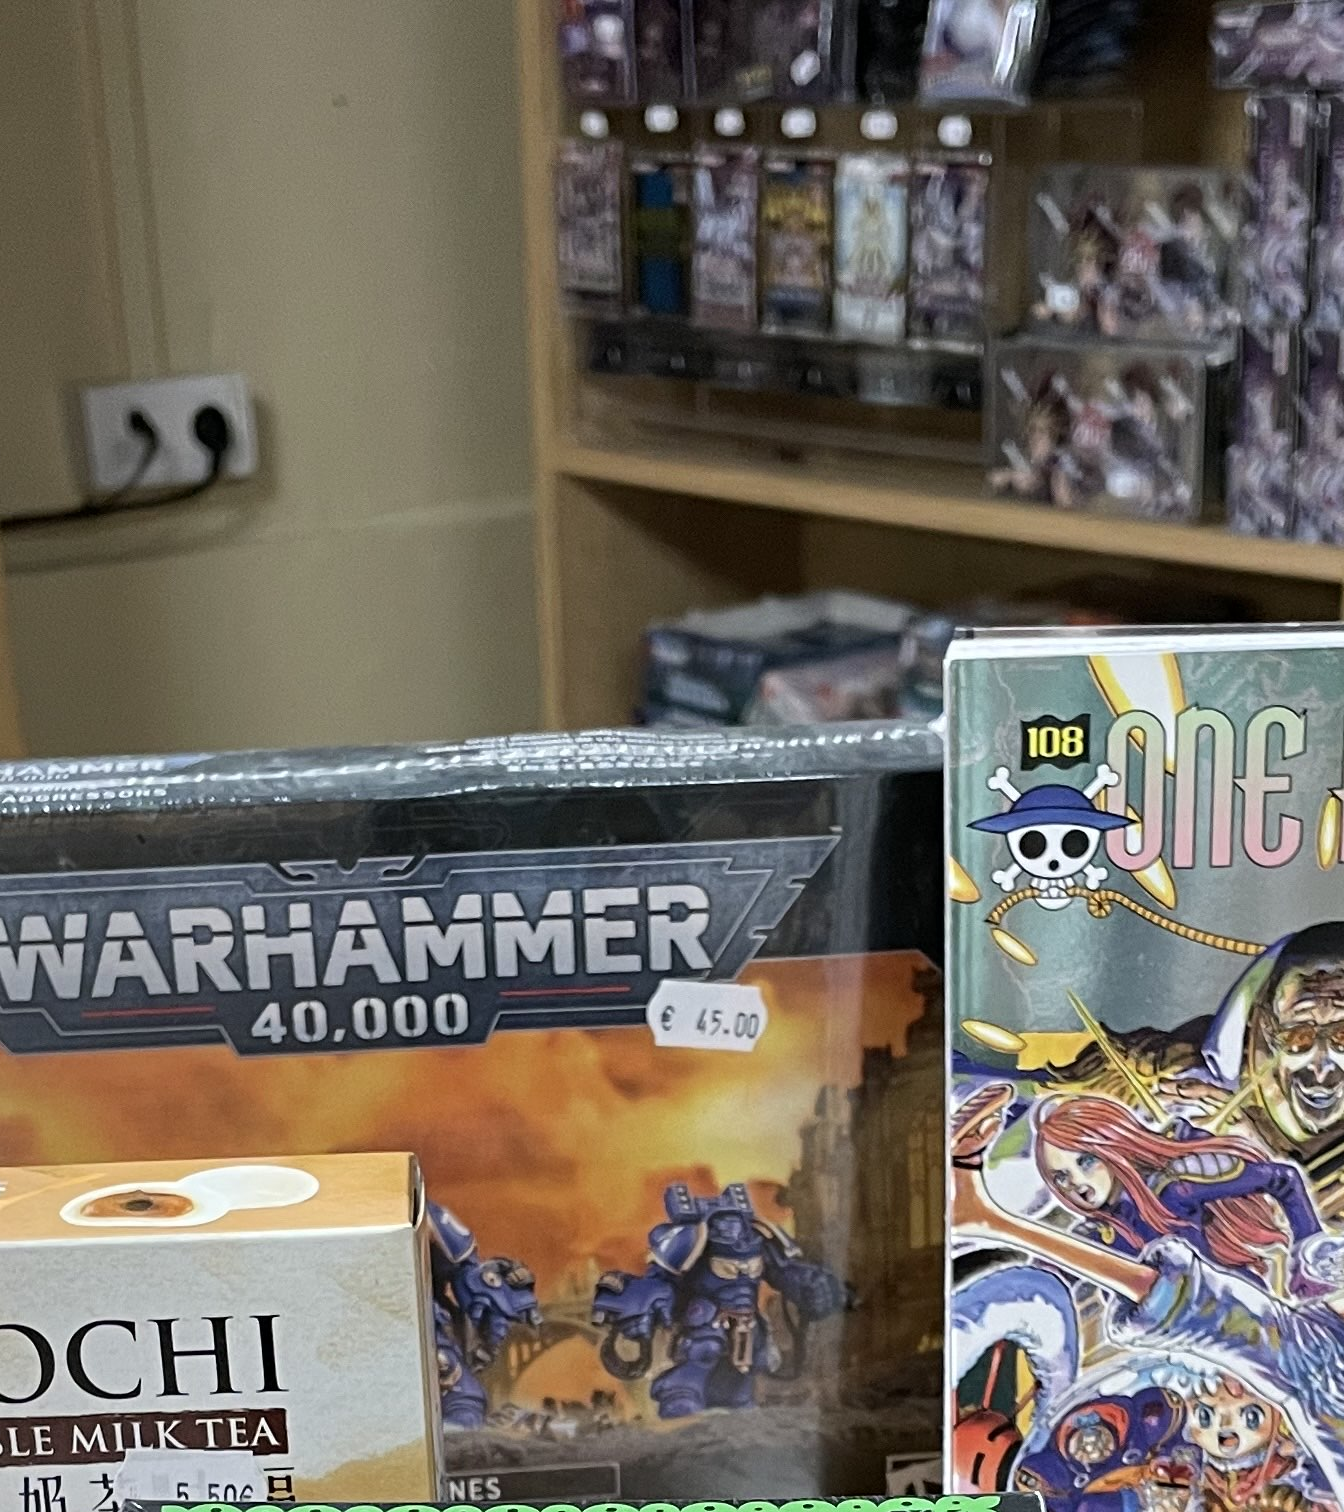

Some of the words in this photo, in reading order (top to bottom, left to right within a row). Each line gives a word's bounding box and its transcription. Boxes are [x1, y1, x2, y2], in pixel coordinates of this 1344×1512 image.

[1027, 726, 1084, 758] 108
[252, 994, 470, 1045] 40,000
[661, 1008, 676, 1032] €
[696, 1010, 760, 1041] 45.00
[71, 1419, 186, 1455] MILK
[195, 1416, 283, 1449] TEA
[449, 1476, 502, 1501] NES
